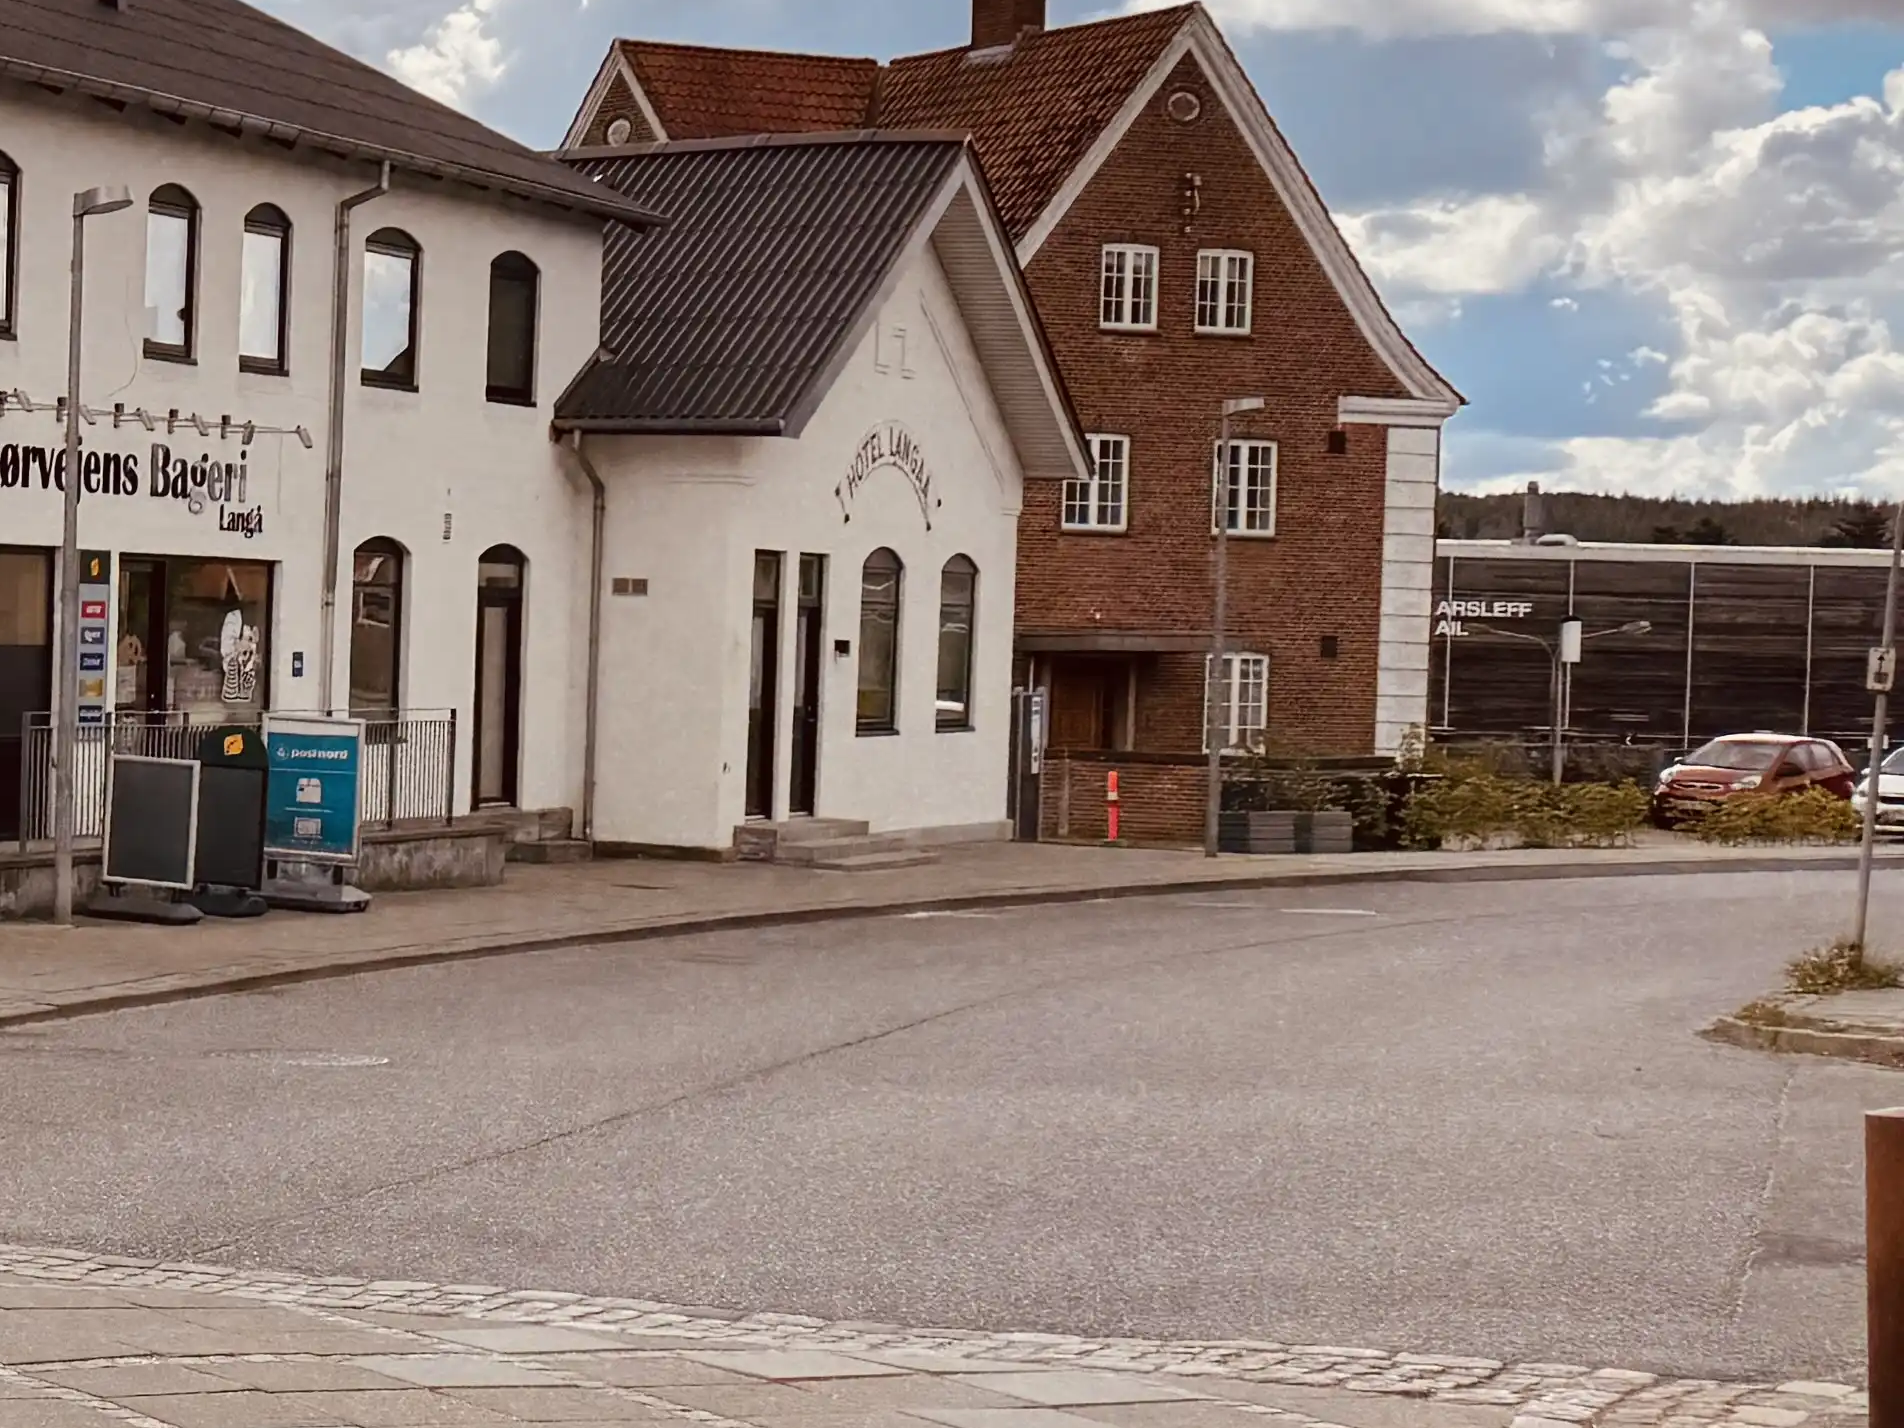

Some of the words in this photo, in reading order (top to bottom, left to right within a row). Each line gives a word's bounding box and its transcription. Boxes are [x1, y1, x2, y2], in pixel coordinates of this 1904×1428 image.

[150, 442, 248, 514] Bageri
[846, 431, 885, 500] HOTEL
[218, 504, 264, 538] Langå
[1435, 600, 1533, 618] ARSLEFF
[290, 748, 349, 760] postnord
